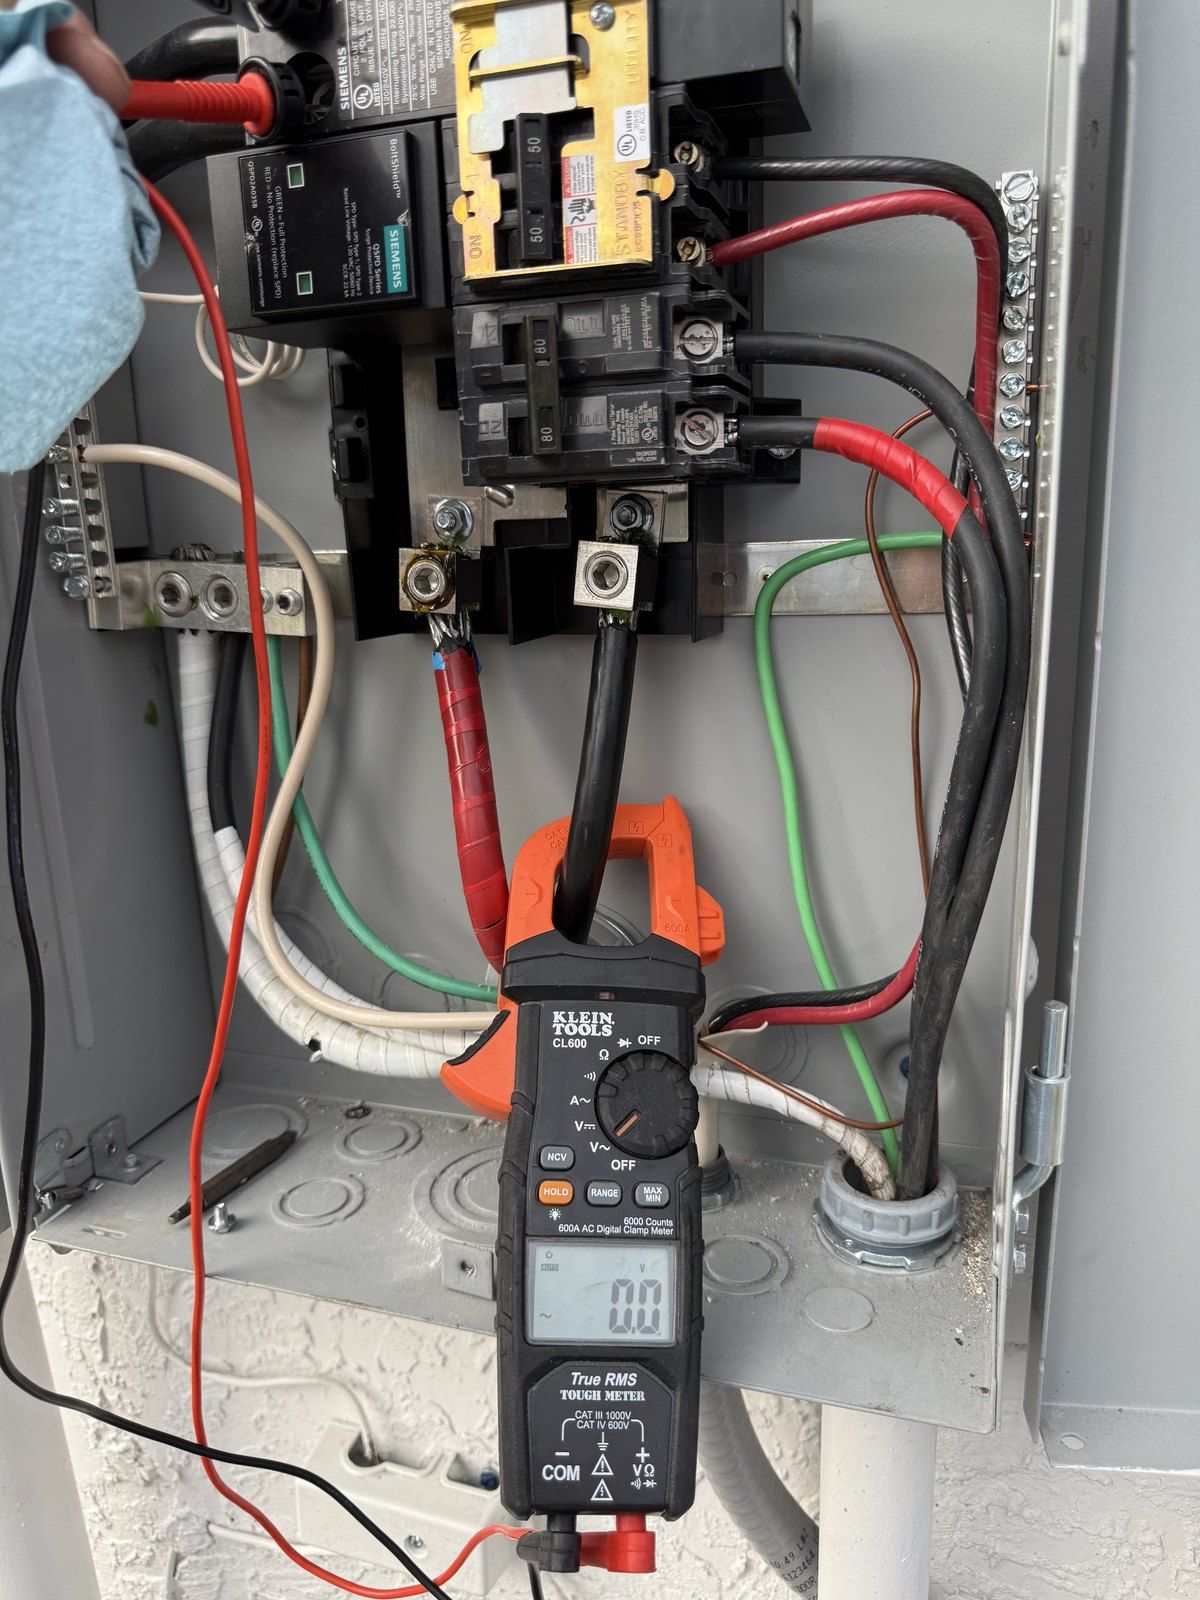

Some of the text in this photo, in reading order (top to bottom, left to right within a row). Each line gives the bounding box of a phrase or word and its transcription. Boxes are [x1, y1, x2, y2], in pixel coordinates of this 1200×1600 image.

[428, 37, 435, 45] IN
[436, 30, 444, 68] SIEMENS
[352, 41, 360, 76] CIRCUIT
[338, 47, 349, 110] SIEMENS
[401, 54, 409, 103] Symmetrical
[527, 138, 541, 153] 50
[266, 192, 273, 203] No
[614, 169, 629, 256] STANDBY
[268, 206, 277, 245] Protection
[274, 186, 283, 213] GREEN
[280, 239, 288, 278] Protection
[530, 227, 543, 243] 50
[469, 235, 482, 258] ON
[373, 244, 381, 266] QSPD
[389, 229, 402, 288] SIEMENS
[270, 248, 279, 279] (replace
[274, 281, 282, 299] SPD)
[534, 339, 546, 354] 80
[541, 427, 553, 442] 80
[545, 828, 562, 840] CAT
[664, 924, 692, 934] 600A
[552, 1023, 613, 1036] TOOLS
[553, 1038, 587, 1048] CL600
[637, 1035, 661, 1045] OFF
[547, 1153, 567, 1162] NCV
[611, 1159, 636, 1171] OFF
[544, 1188, 569, 1196] HOLD
[591, 1189, 619, 1197] RANGE
[643, 1186, 662, 1195] MAX
[645, 1194, 661, 1203] MIN
[623, 1217, 674, 1226] 6000 Counts
[558, 1224, 674, 1236] 600A AC Digital Clamp Meter
[640, 1263, 645, 1273] V
[609, 1279, 661, 1334] 0.0
[571, 1372, 638, 1386] True RMS
[560, 1390, 645, 1402] TOUGH METER
[575, 1410, 632, 1420] CAT III 1000V
[577, 1420, 630, 1430] CAT IV 600V
[542, 1464, 580, 1481] COM
